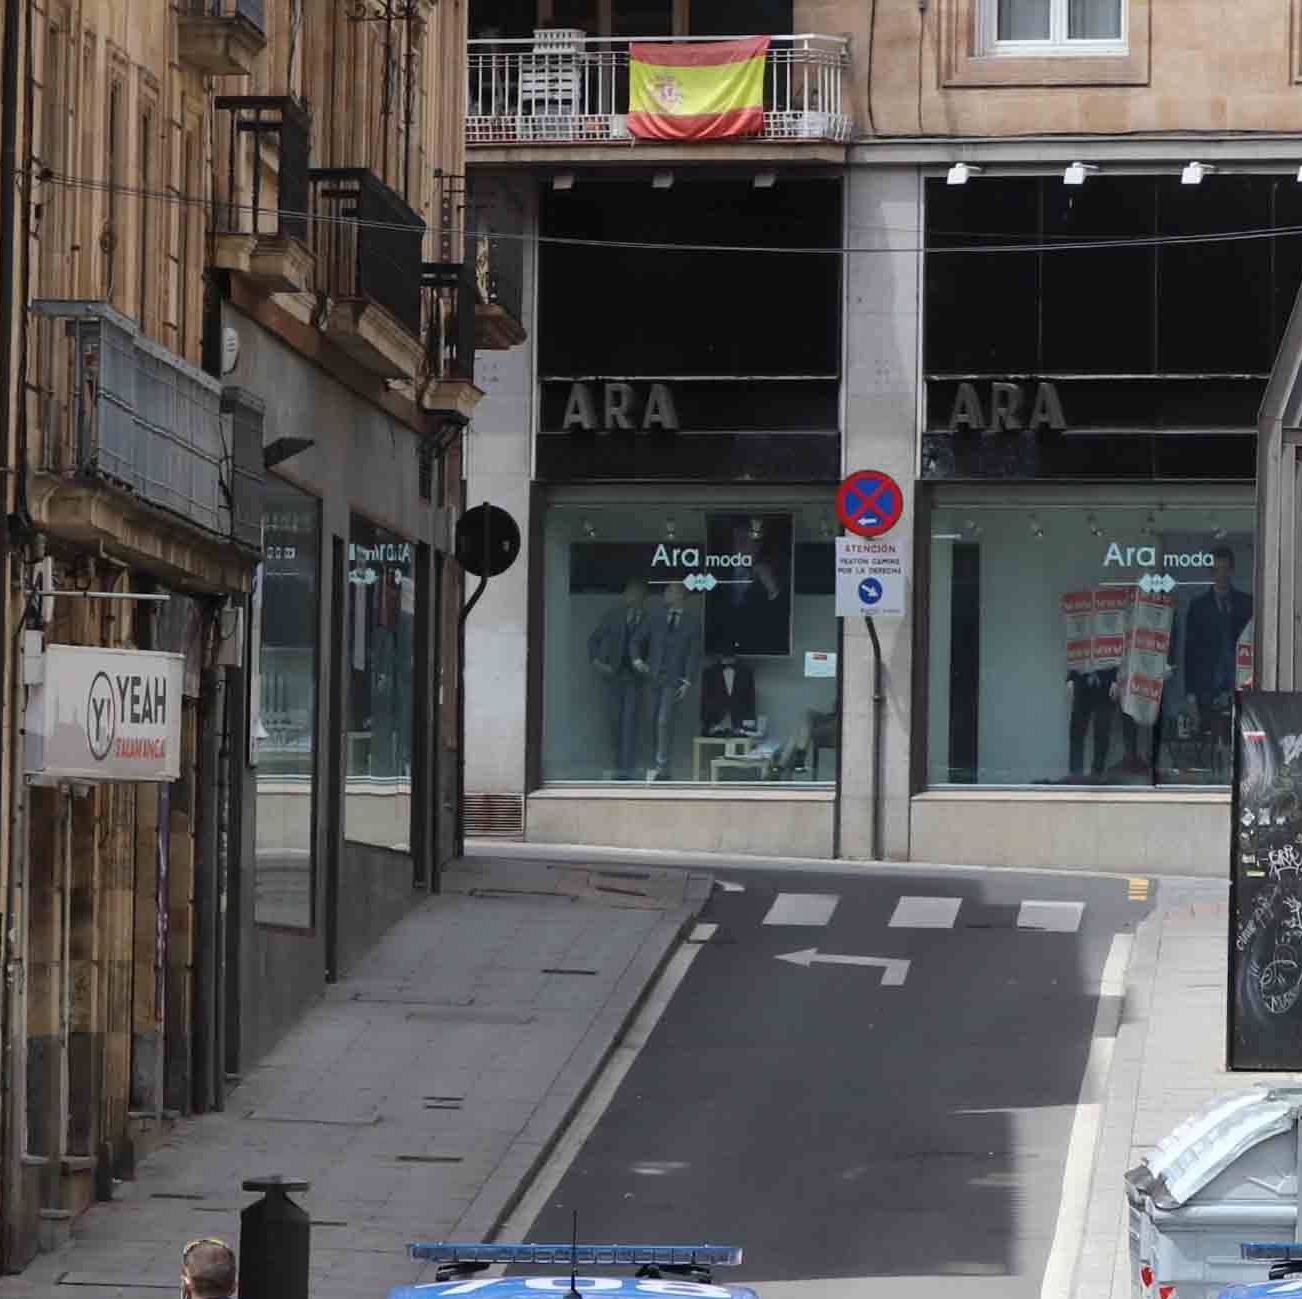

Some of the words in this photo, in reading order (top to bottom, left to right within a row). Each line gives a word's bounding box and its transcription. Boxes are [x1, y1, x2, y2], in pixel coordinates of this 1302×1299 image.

[562, 383, 680, 429] ARA
[947, 382, 1068, 429] ARA
[651, 544, 699, 567] Ara
[705, 552, 753, 567] moda
[1103, 542, 1156, 567] Ara
[1163, 552, 1215, 567] moda
[115, 676, 167, 725] YEAH
